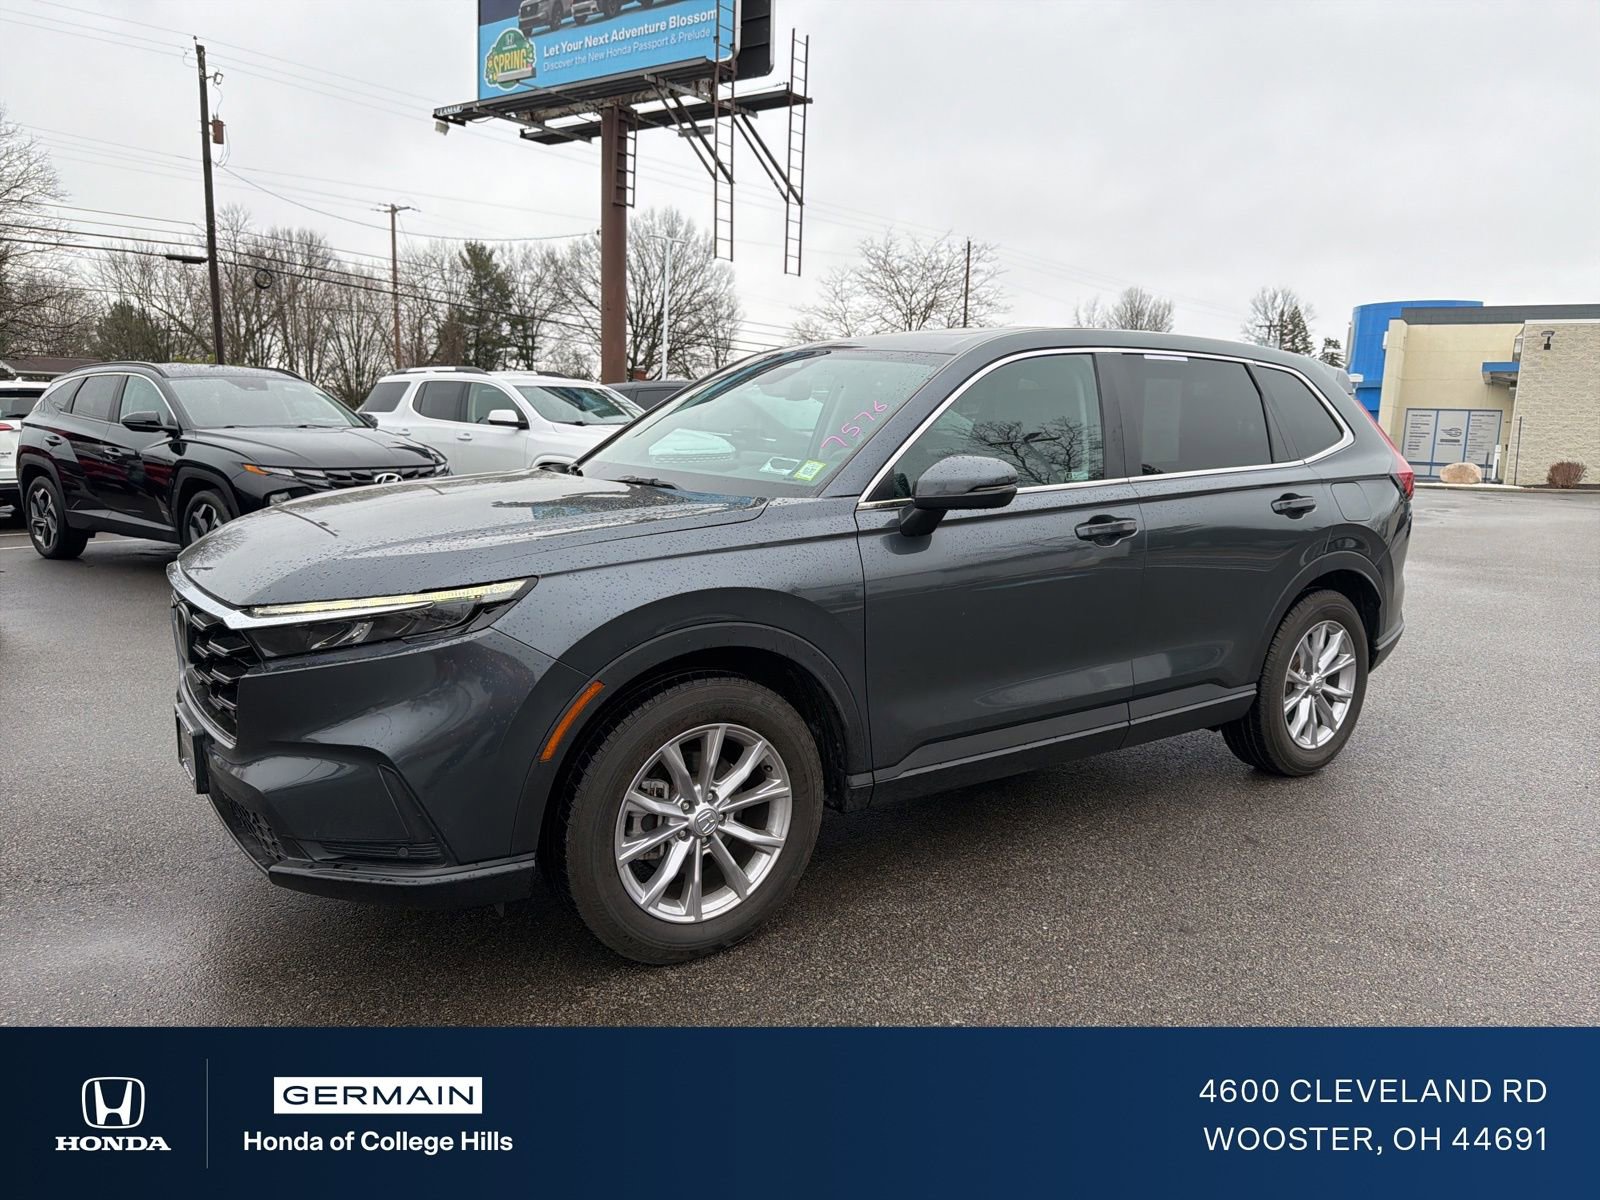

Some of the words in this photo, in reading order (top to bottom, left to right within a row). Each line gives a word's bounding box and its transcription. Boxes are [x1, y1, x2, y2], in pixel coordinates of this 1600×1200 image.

[543, 44, 559, 58] Let
[561, 39, 584, 54] Your
[584, 32, 609, 49] Next
[610, 20, 667, 43] Adventure
[669, 8, 717, 30] Blossom
[543, 57, 574, 72] Discover
[575, 54, 587, 66] the
[588, 50, 605, 63] New
[606, 45, 631, 59] Honda
[633, 36, 669, 53] Passport
[670, 33, 677, 45] &
[678, 27, 711, 43] Prelude
[493, 48, 527, 73] SPRING
[821, 400, 888, 448] 7576
